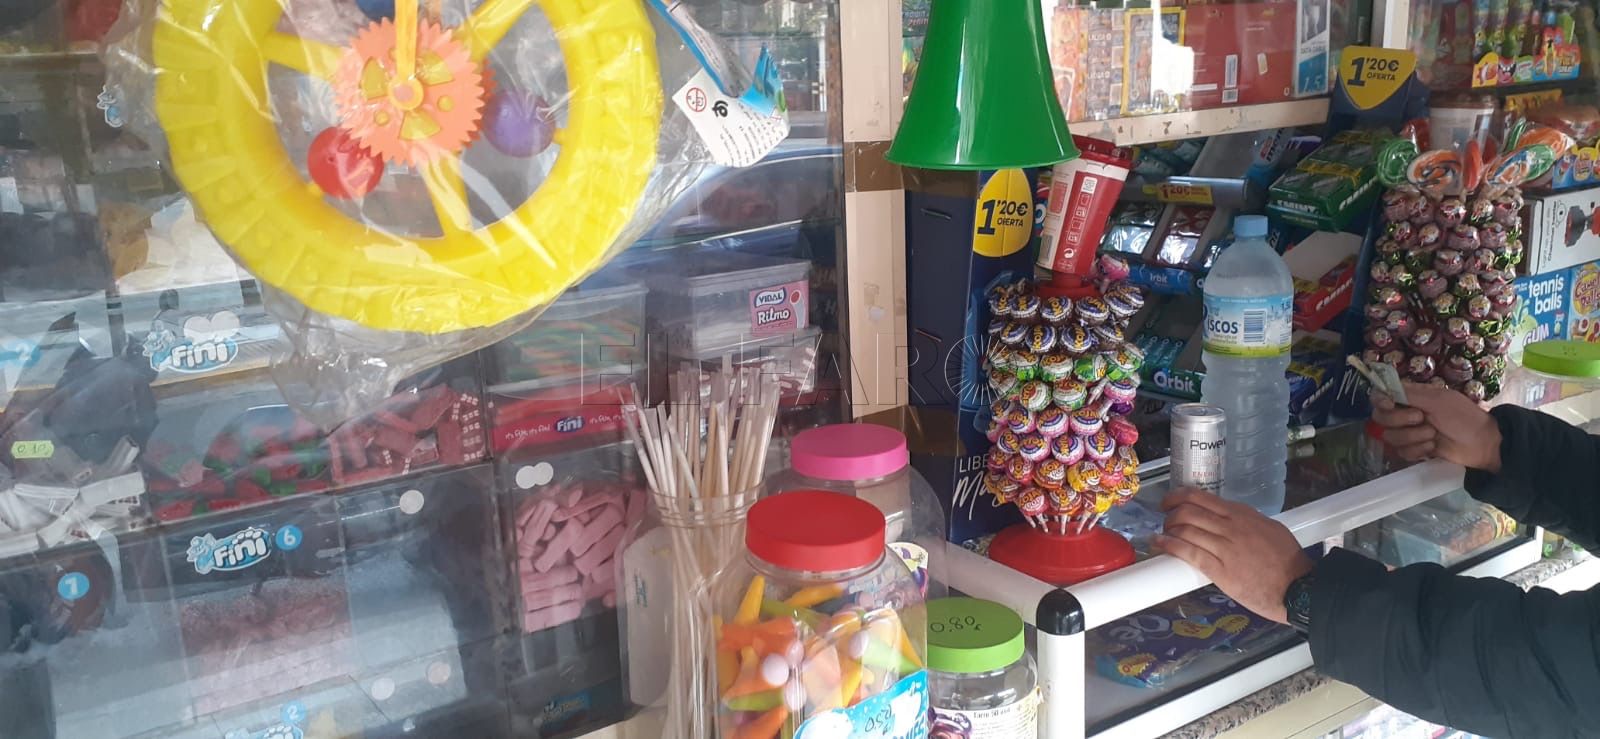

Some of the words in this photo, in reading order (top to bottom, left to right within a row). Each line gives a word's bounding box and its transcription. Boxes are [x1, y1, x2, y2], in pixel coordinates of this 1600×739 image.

[1366, 72, 1396, 82] OFERTA
[996, 217, 1024, 227] OFERTA
[1528, 273, 1564, 298] tennis
[758, 291, 783, 304] VIDAL
[1534, 292, 1562, 315] balls
[757, 307, 790, 325] Ritmo
[1523, 322, 1550, 345] GUM
[1154, 370, 1196, 393] Orbit
[556, 415, 583, 432] Fini
[283, 527, 297, 545] 6
[212, 531, 267, 568] Fini
[286, 704, 299, 720] 2
